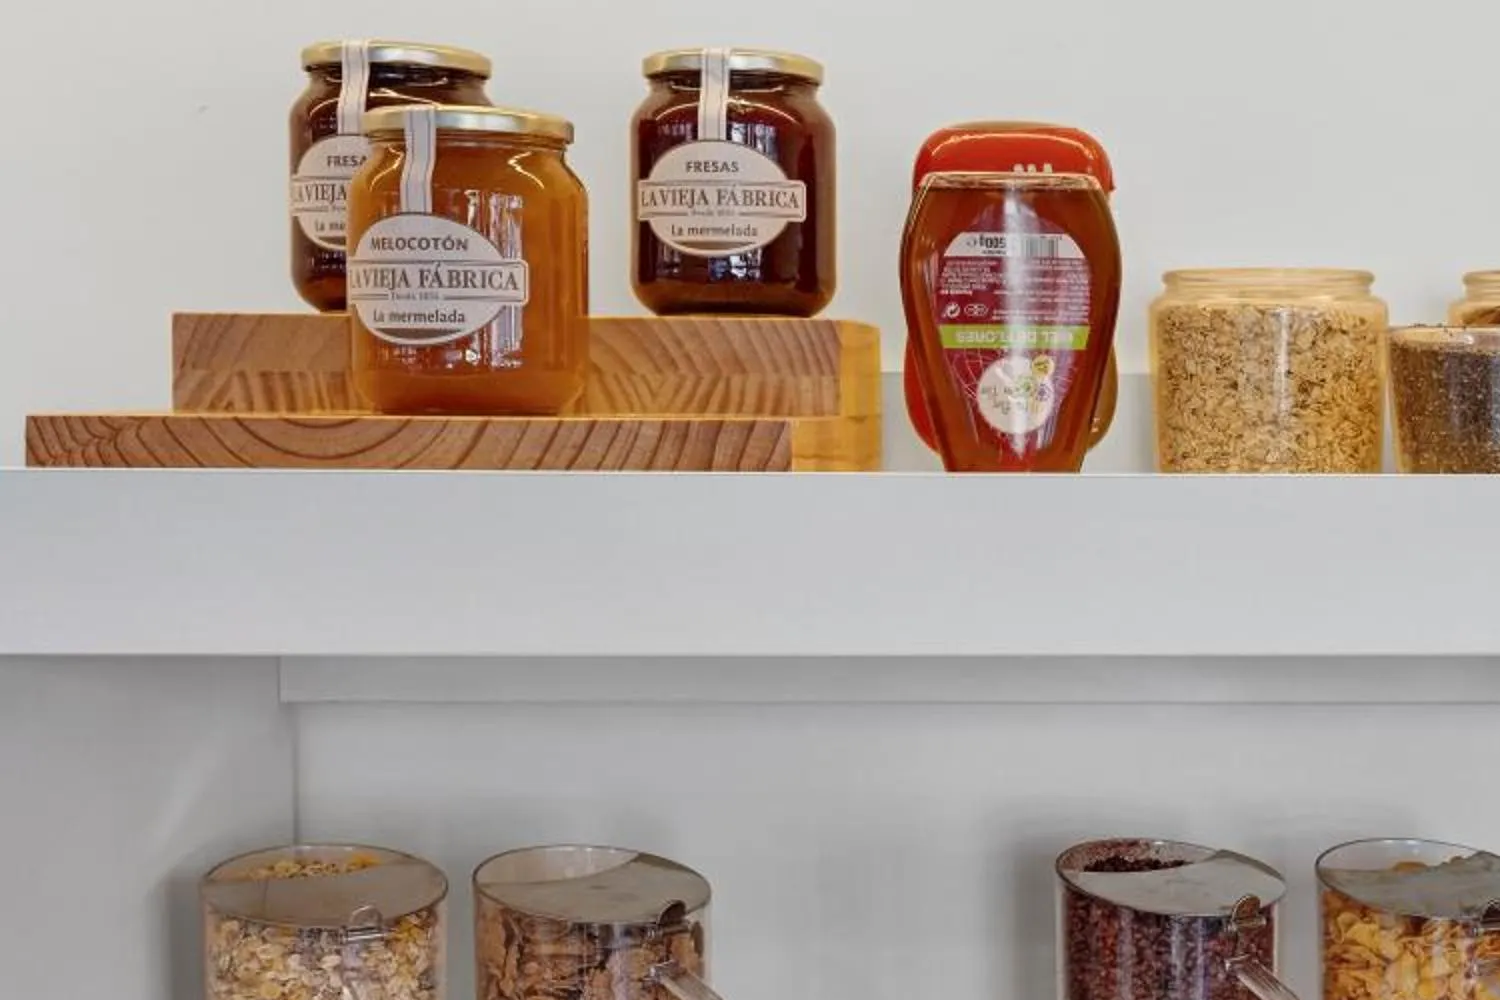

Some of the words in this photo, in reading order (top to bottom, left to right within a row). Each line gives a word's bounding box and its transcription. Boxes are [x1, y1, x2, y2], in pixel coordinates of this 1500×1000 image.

[685, 160, 740, 173] FRESAS
[304, 182, 347, 205] VIEJA
[641, 190, 658, 207] LA
[658, 187, 710, 209] VIEJA
[715, 183, 800, 209] FÁBRICA
[671, 223, 684, 237] La
[687, 223, 759, 238] mermelada
[370, 233, 470, 252] MELOCOTÓN
[362, 267, 411, 291] VIEJA
[418, 260, 520, 291] FÁBRICA
[373, 307, 385, 323] La
[388, 308, 466, 324] mermelada
